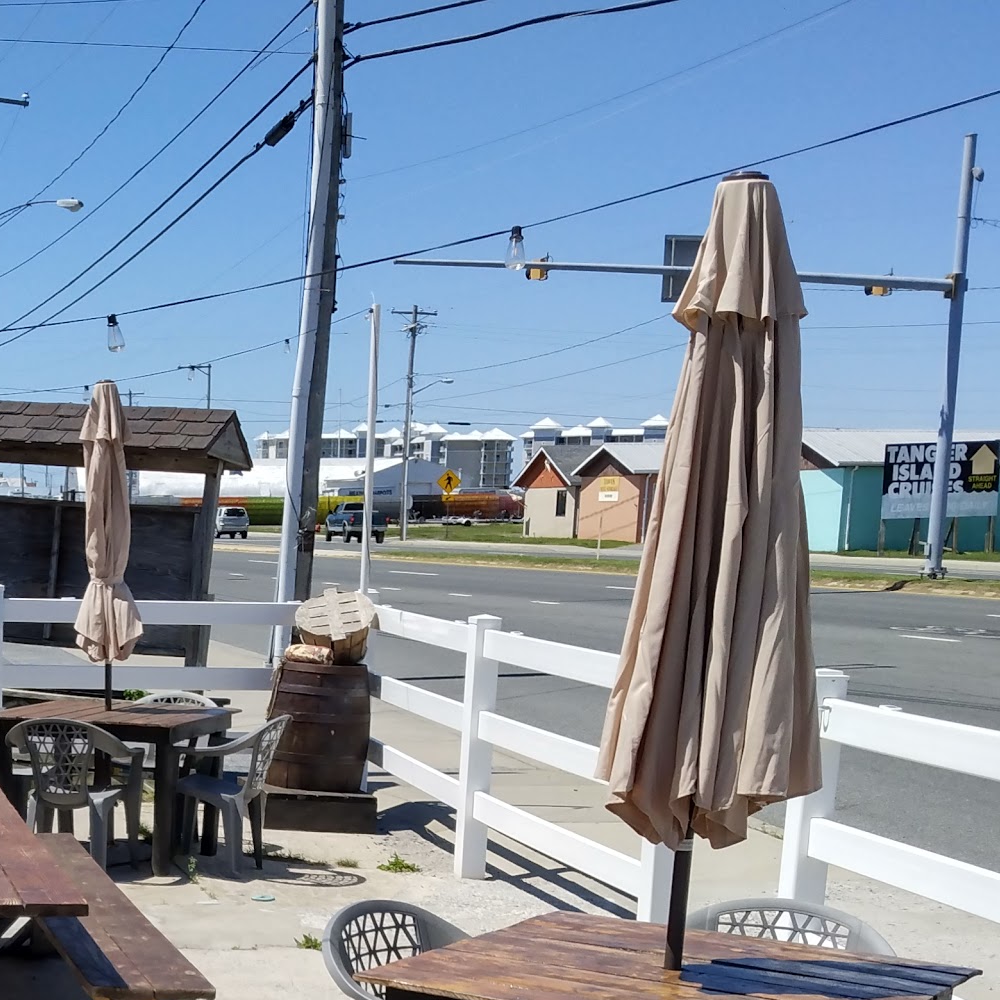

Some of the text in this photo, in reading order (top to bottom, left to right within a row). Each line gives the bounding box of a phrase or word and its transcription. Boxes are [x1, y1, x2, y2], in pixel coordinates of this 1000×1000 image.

[887, 443, 968, 464] TANGER
[892, 462, 962, 481] ISLAD
[968, 475, 997, 483] STRAIGHT
[887, 480, 964, 498] CRUIES
[972, 482, 992, 490] AHEAD
